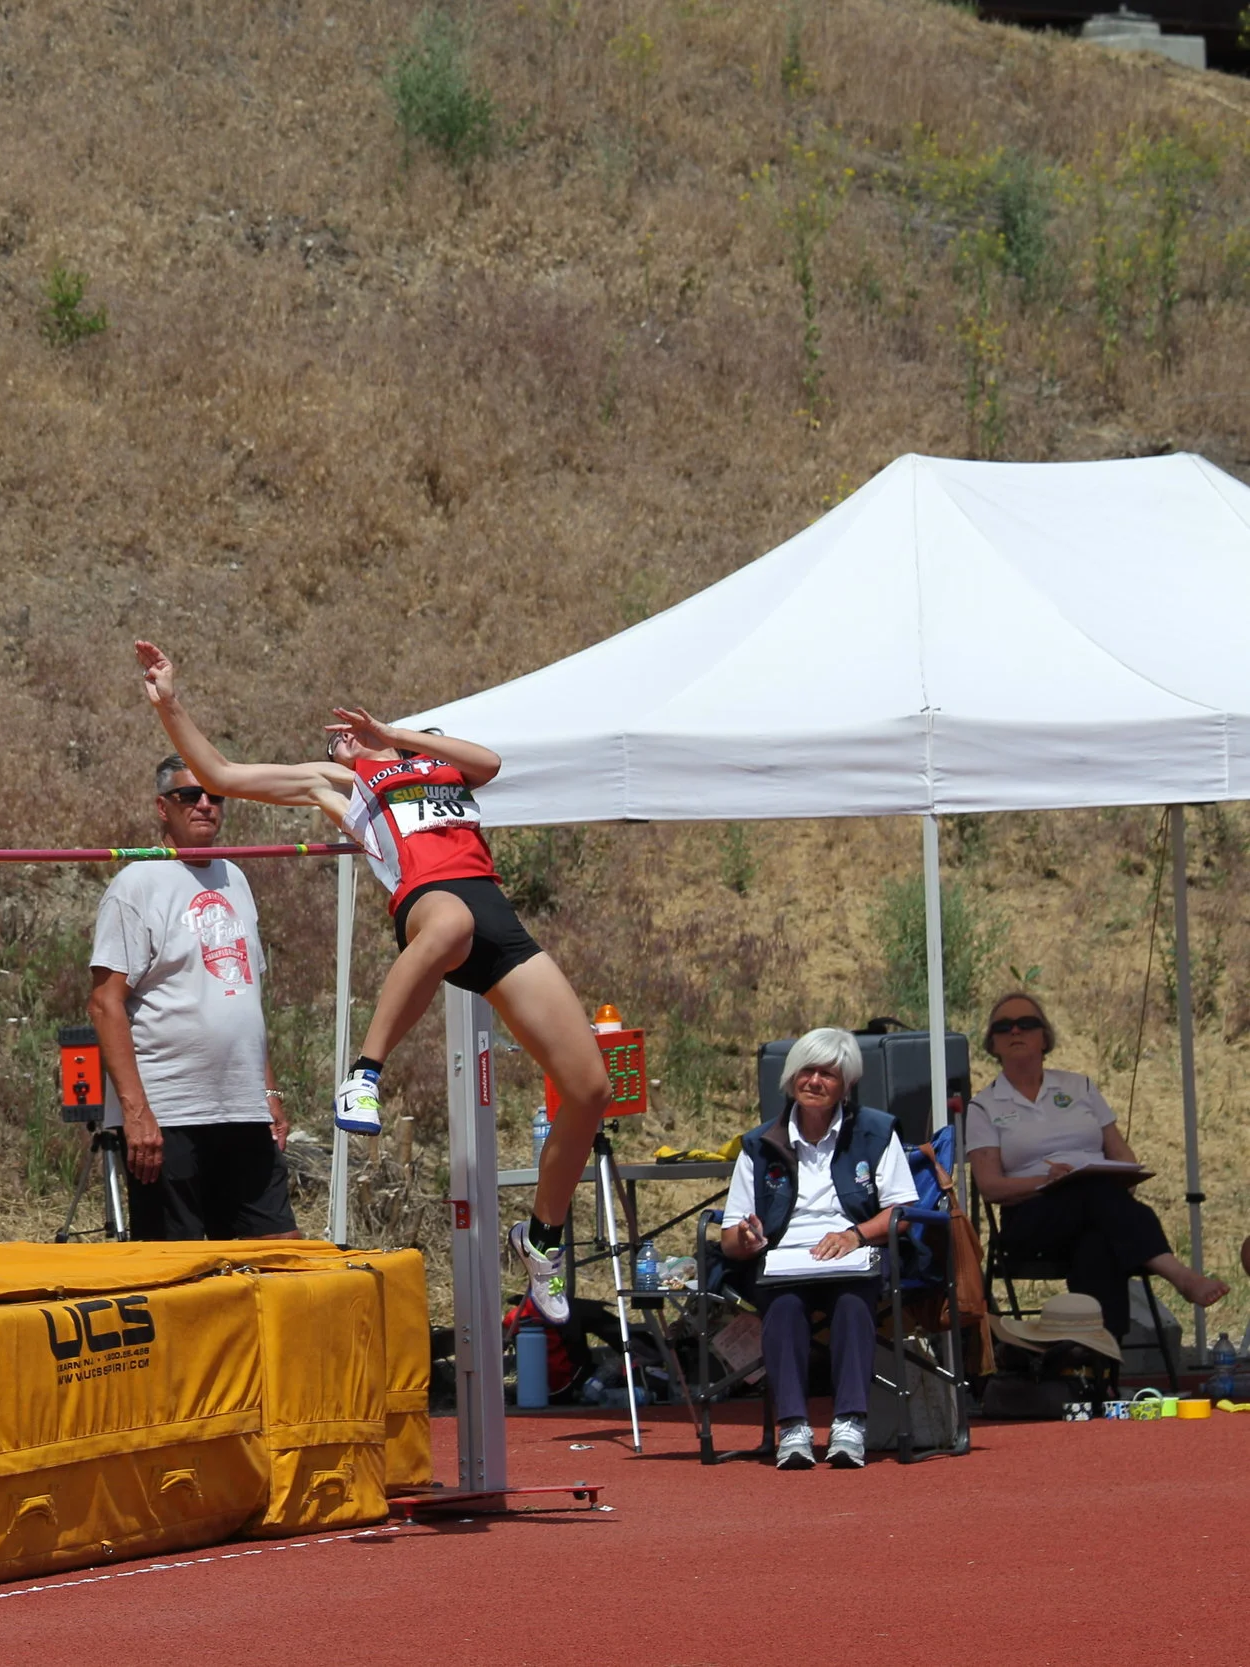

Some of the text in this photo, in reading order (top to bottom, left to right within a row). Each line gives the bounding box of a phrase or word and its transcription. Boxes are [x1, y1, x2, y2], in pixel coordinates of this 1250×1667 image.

[368, 764, 404, 789] HOLY
[393, 785, 464, 803] SUBWAY
[408, 799, 465, 821] 730
[38, 1295, 155, 1361] UCS
